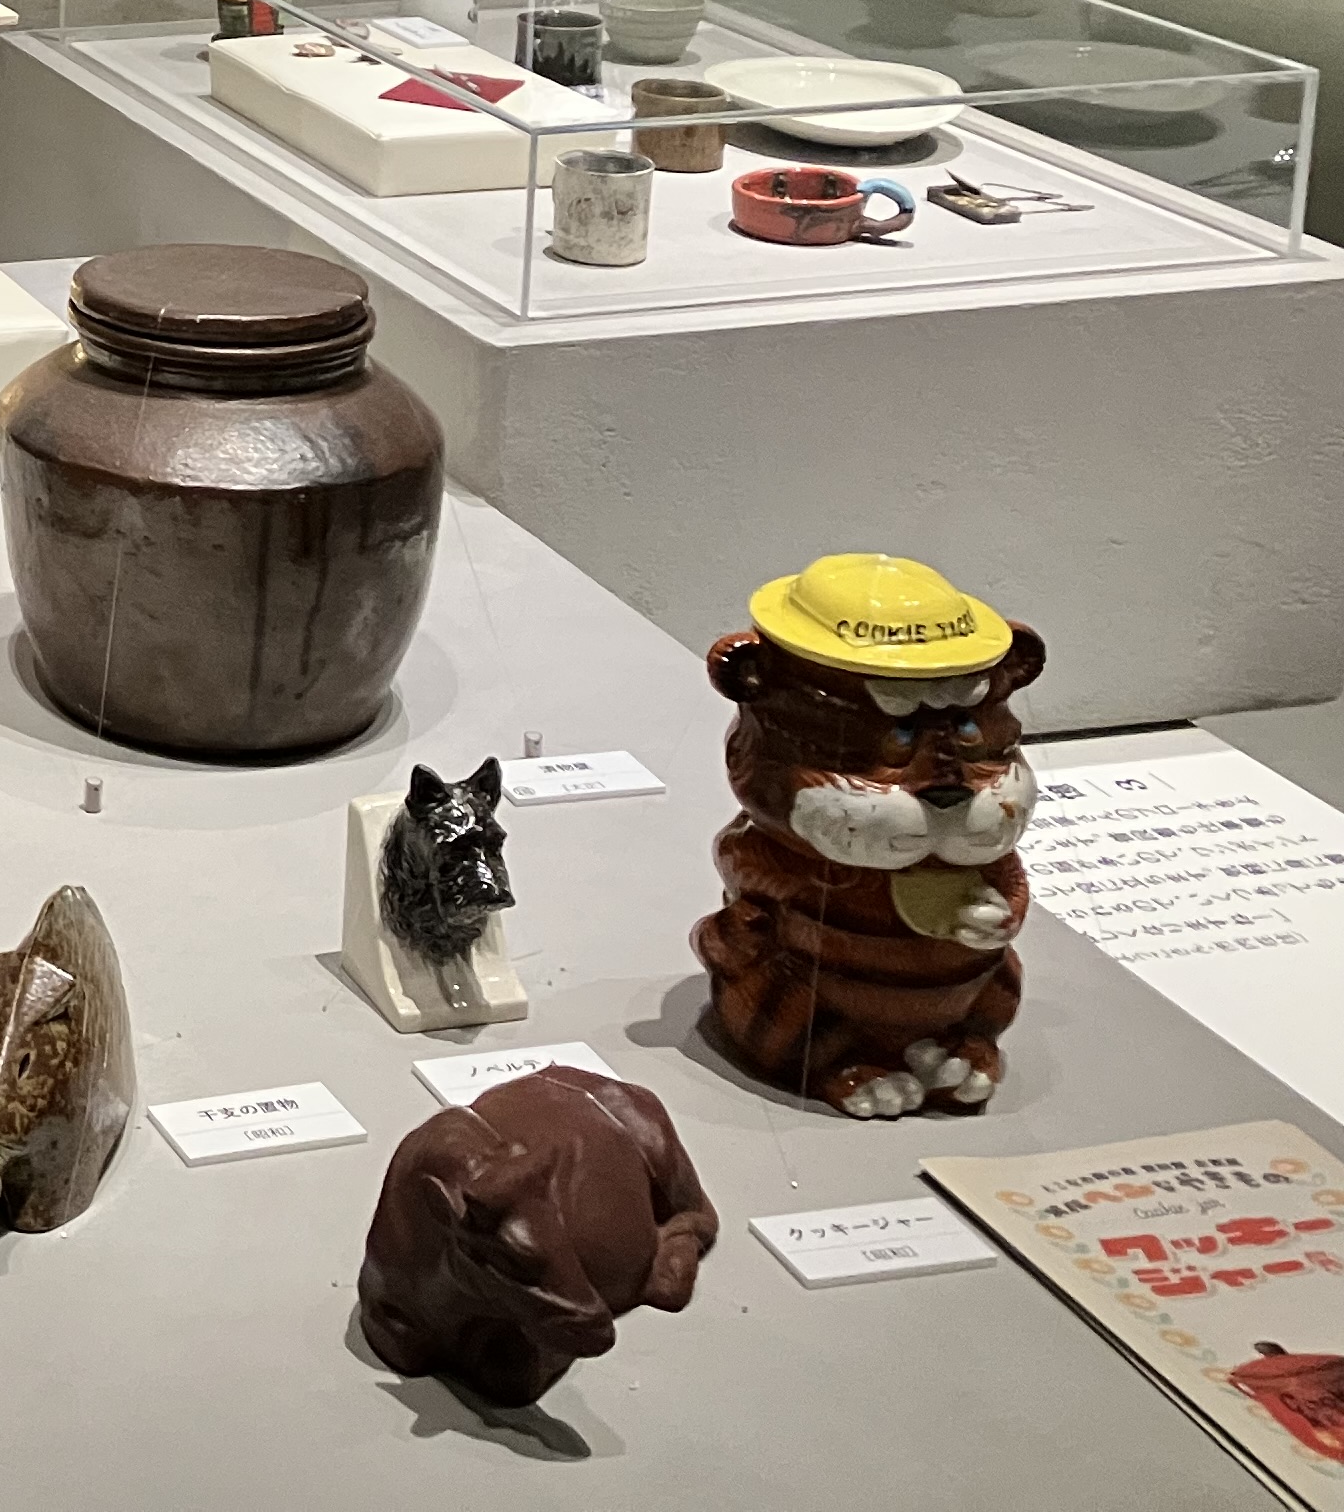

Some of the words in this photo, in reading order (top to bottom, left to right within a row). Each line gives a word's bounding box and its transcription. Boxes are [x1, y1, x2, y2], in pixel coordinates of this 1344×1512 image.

[471, 1060, 544, 1077] ノベルテ
[197, 1098, 299, 1121] 干支の置物
